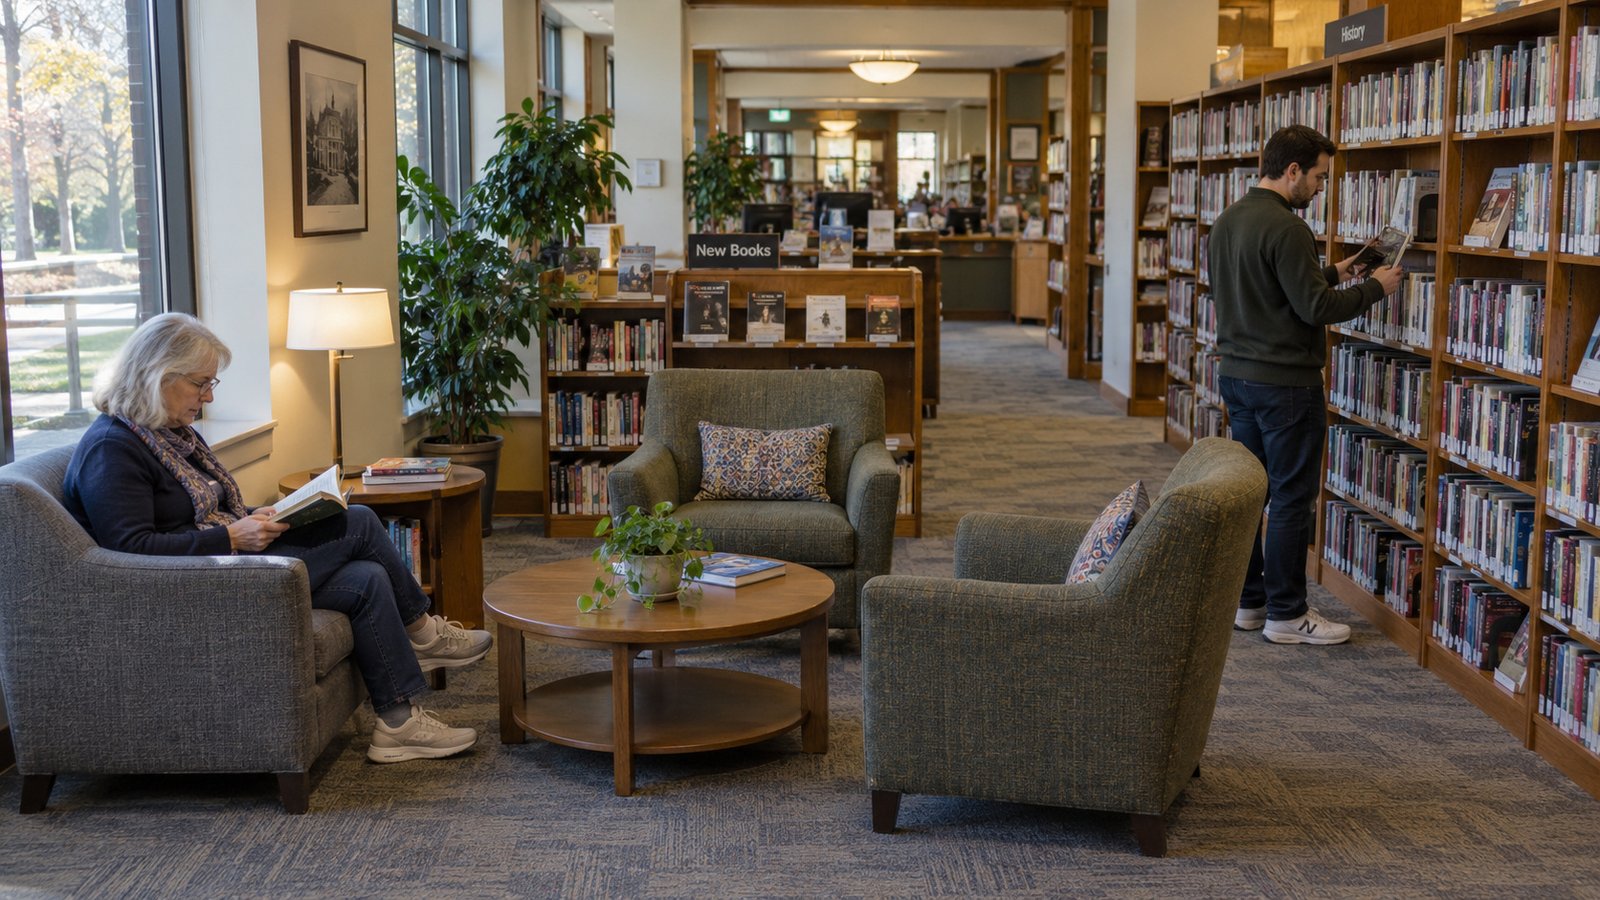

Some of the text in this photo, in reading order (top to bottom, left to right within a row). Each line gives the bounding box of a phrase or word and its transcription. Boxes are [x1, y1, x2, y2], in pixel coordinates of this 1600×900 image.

[1341, 25, 1366, 43] History
[696, 243, 772, 257] New Books
[1298, 619, 1317, 634] N
